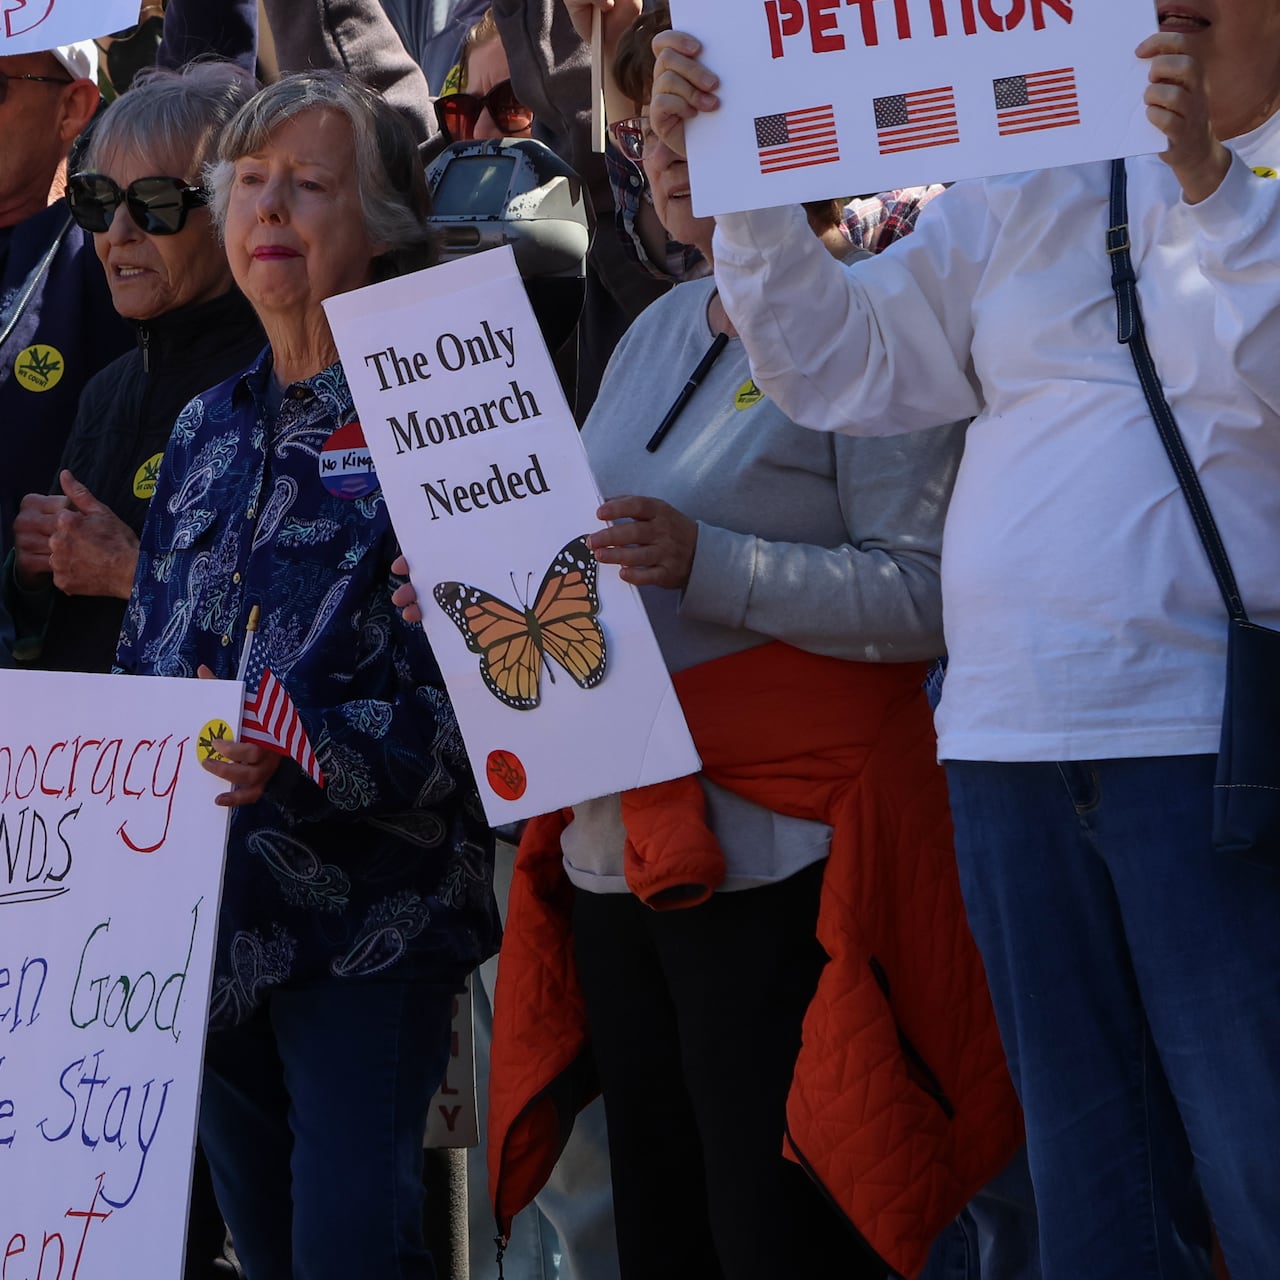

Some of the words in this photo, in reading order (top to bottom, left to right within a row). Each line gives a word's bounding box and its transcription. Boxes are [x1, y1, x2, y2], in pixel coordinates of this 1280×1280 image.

[364, 344, 429, 392] The
[436, 320, 518, 372] Only
[385, 380, 543, 455] Monarch
[322, 458, 338, 473] No
[342, 451, 376, 473] King
[421, 454, 551, 521] Needed
[69, 897, 204, 1043] Good
[36, 1049, 175, 1209] Stay
